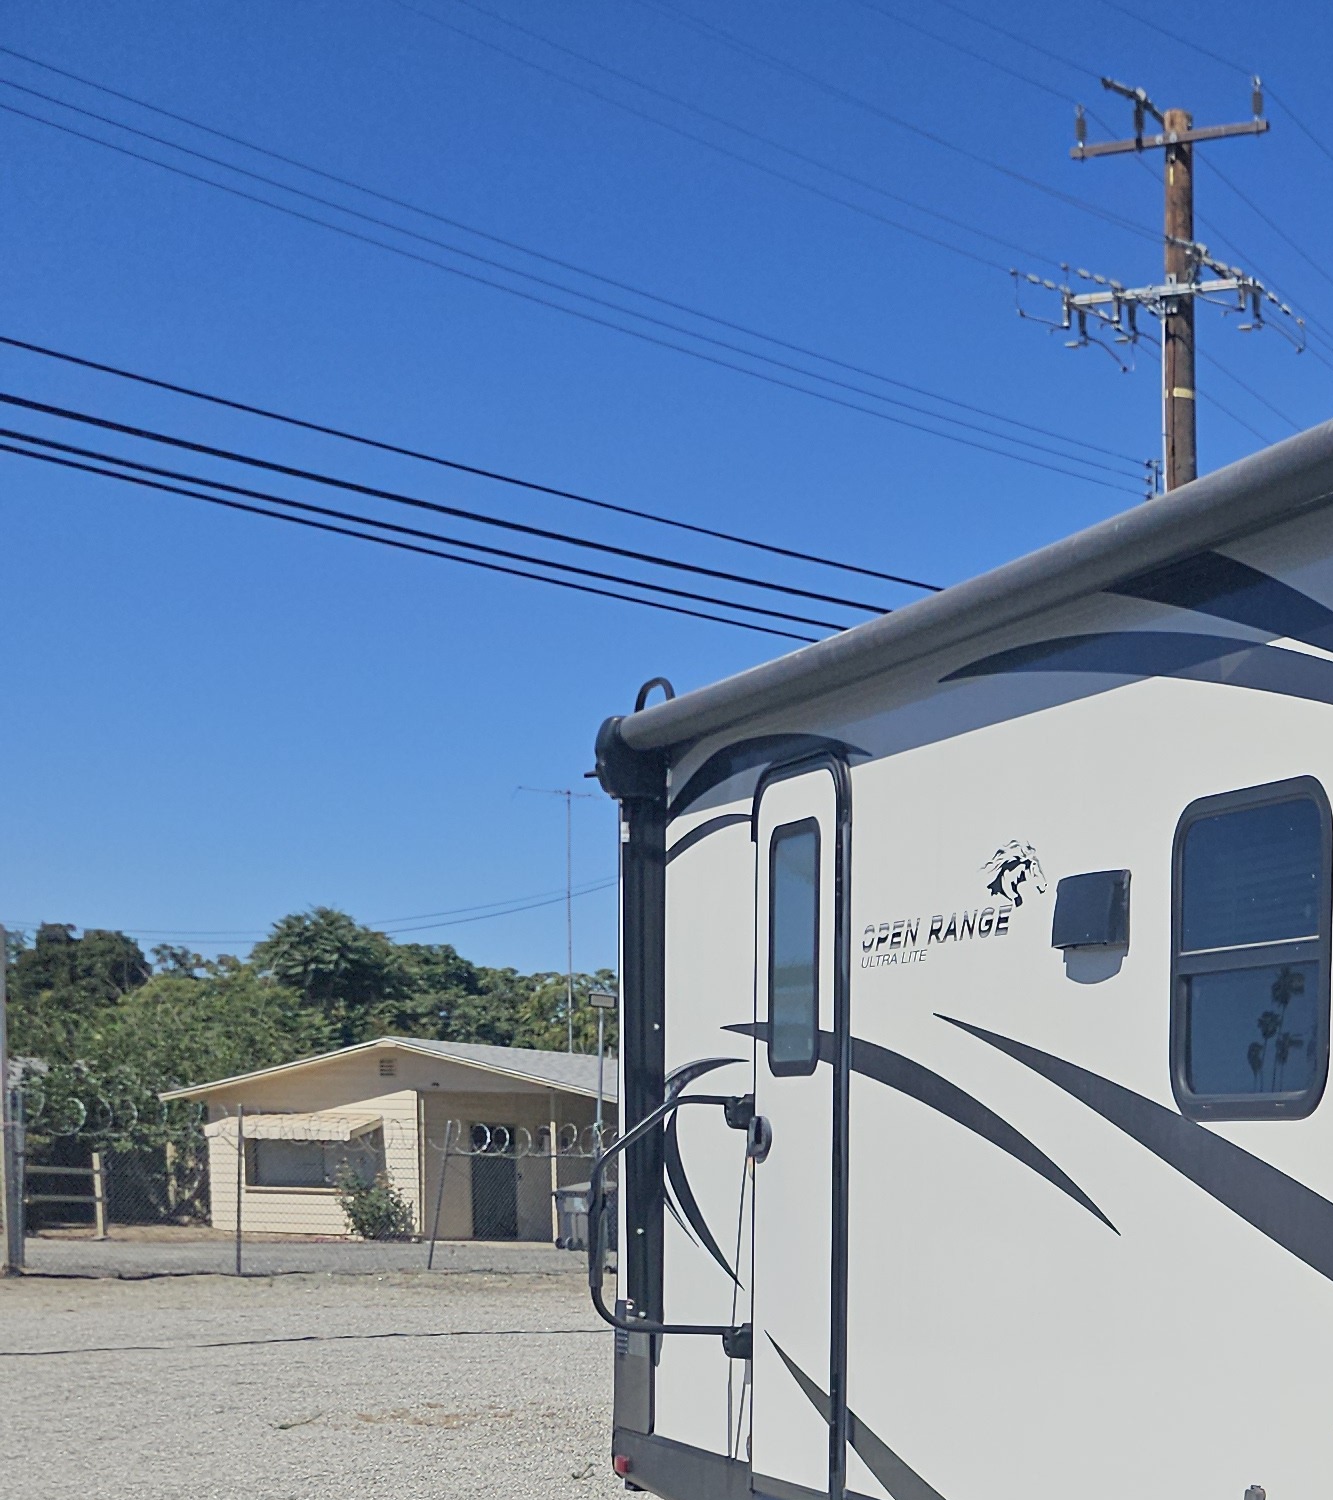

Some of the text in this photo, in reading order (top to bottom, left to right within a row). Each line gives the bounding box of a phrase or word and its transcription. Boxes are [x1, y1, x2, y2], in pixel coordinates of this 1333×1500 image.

[862, 904, 1013, 953] OPEN RANGE
[861, 949, 928, 969] ULTRA LITE
